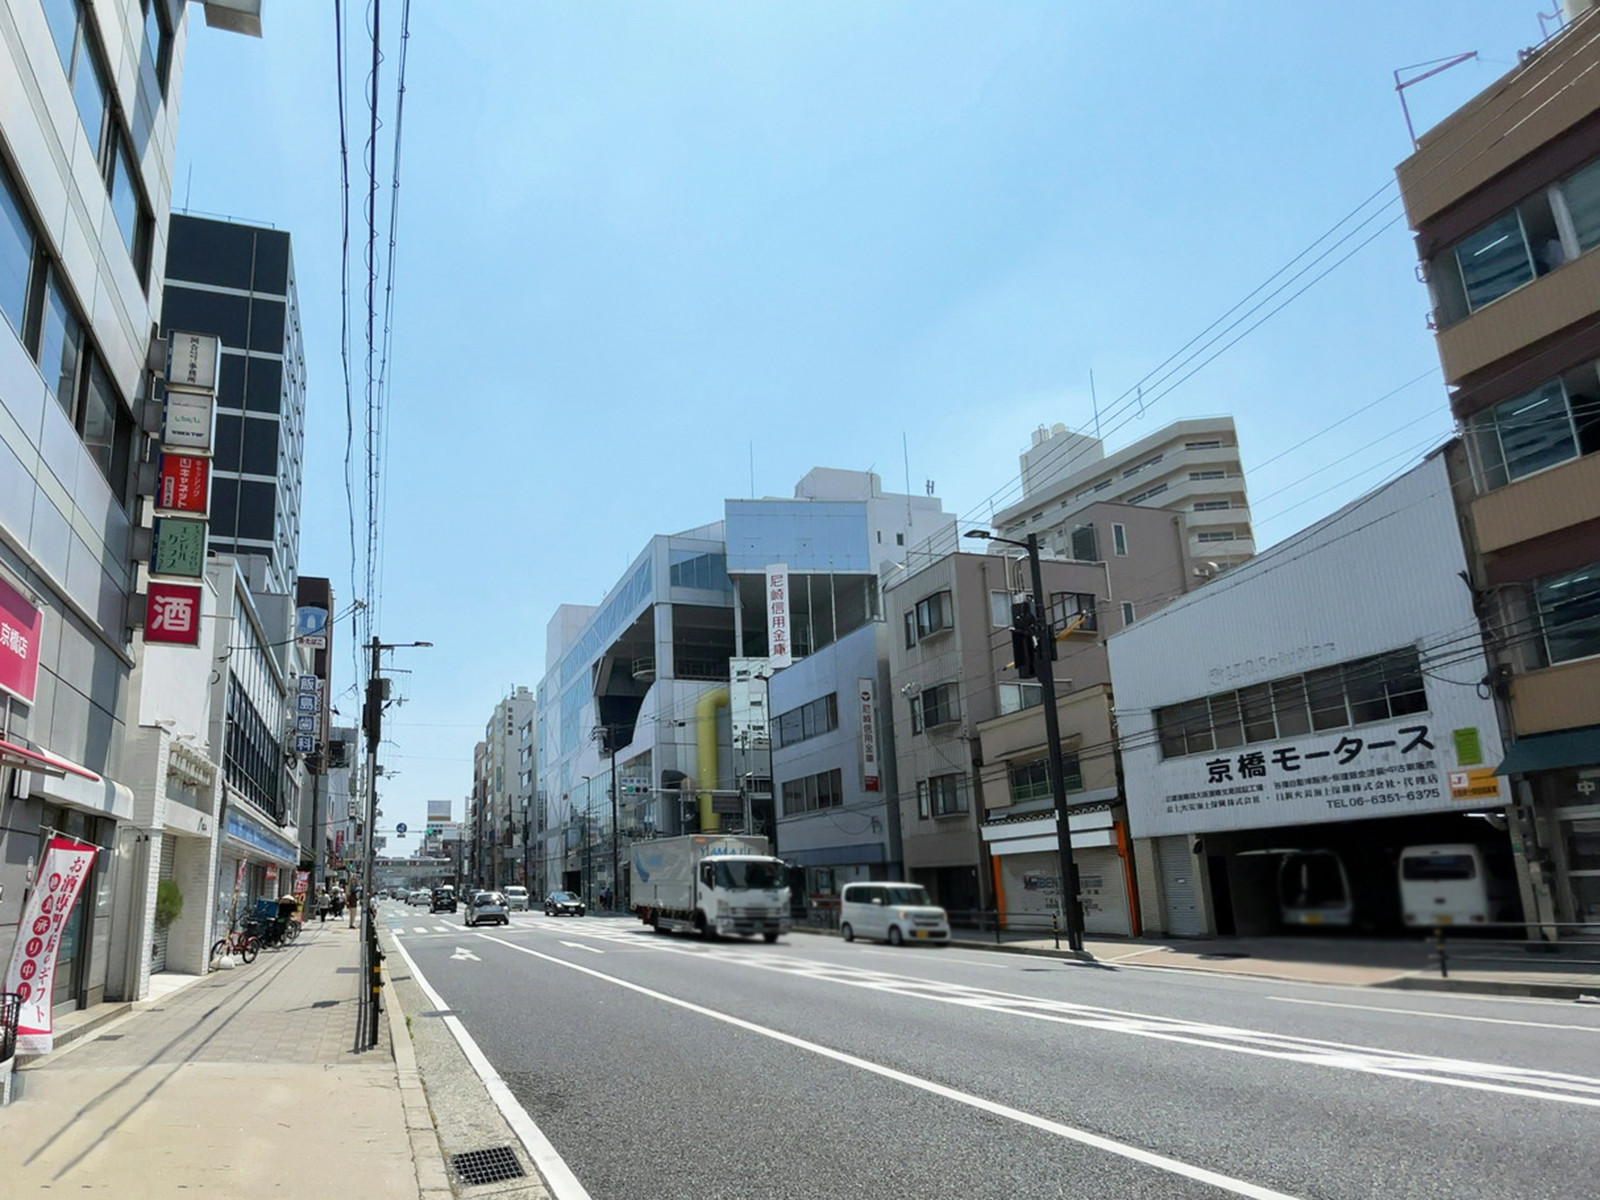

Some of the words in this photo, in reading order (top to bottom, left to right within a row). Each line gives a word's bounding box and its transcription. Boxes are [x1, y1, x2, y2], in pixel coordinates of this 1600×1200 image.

[0, 622, 28, 659] 京橋店
[151, 595, 193, 631] 酒
[770, 574, 787, 656] 尼崎信用金庫
[296, 677, 315, 752] 飯島歯科
[862, 703, 874, 763] 尼崎信用金庫
[1205, 725, 1435, 785] 京橋モータース
